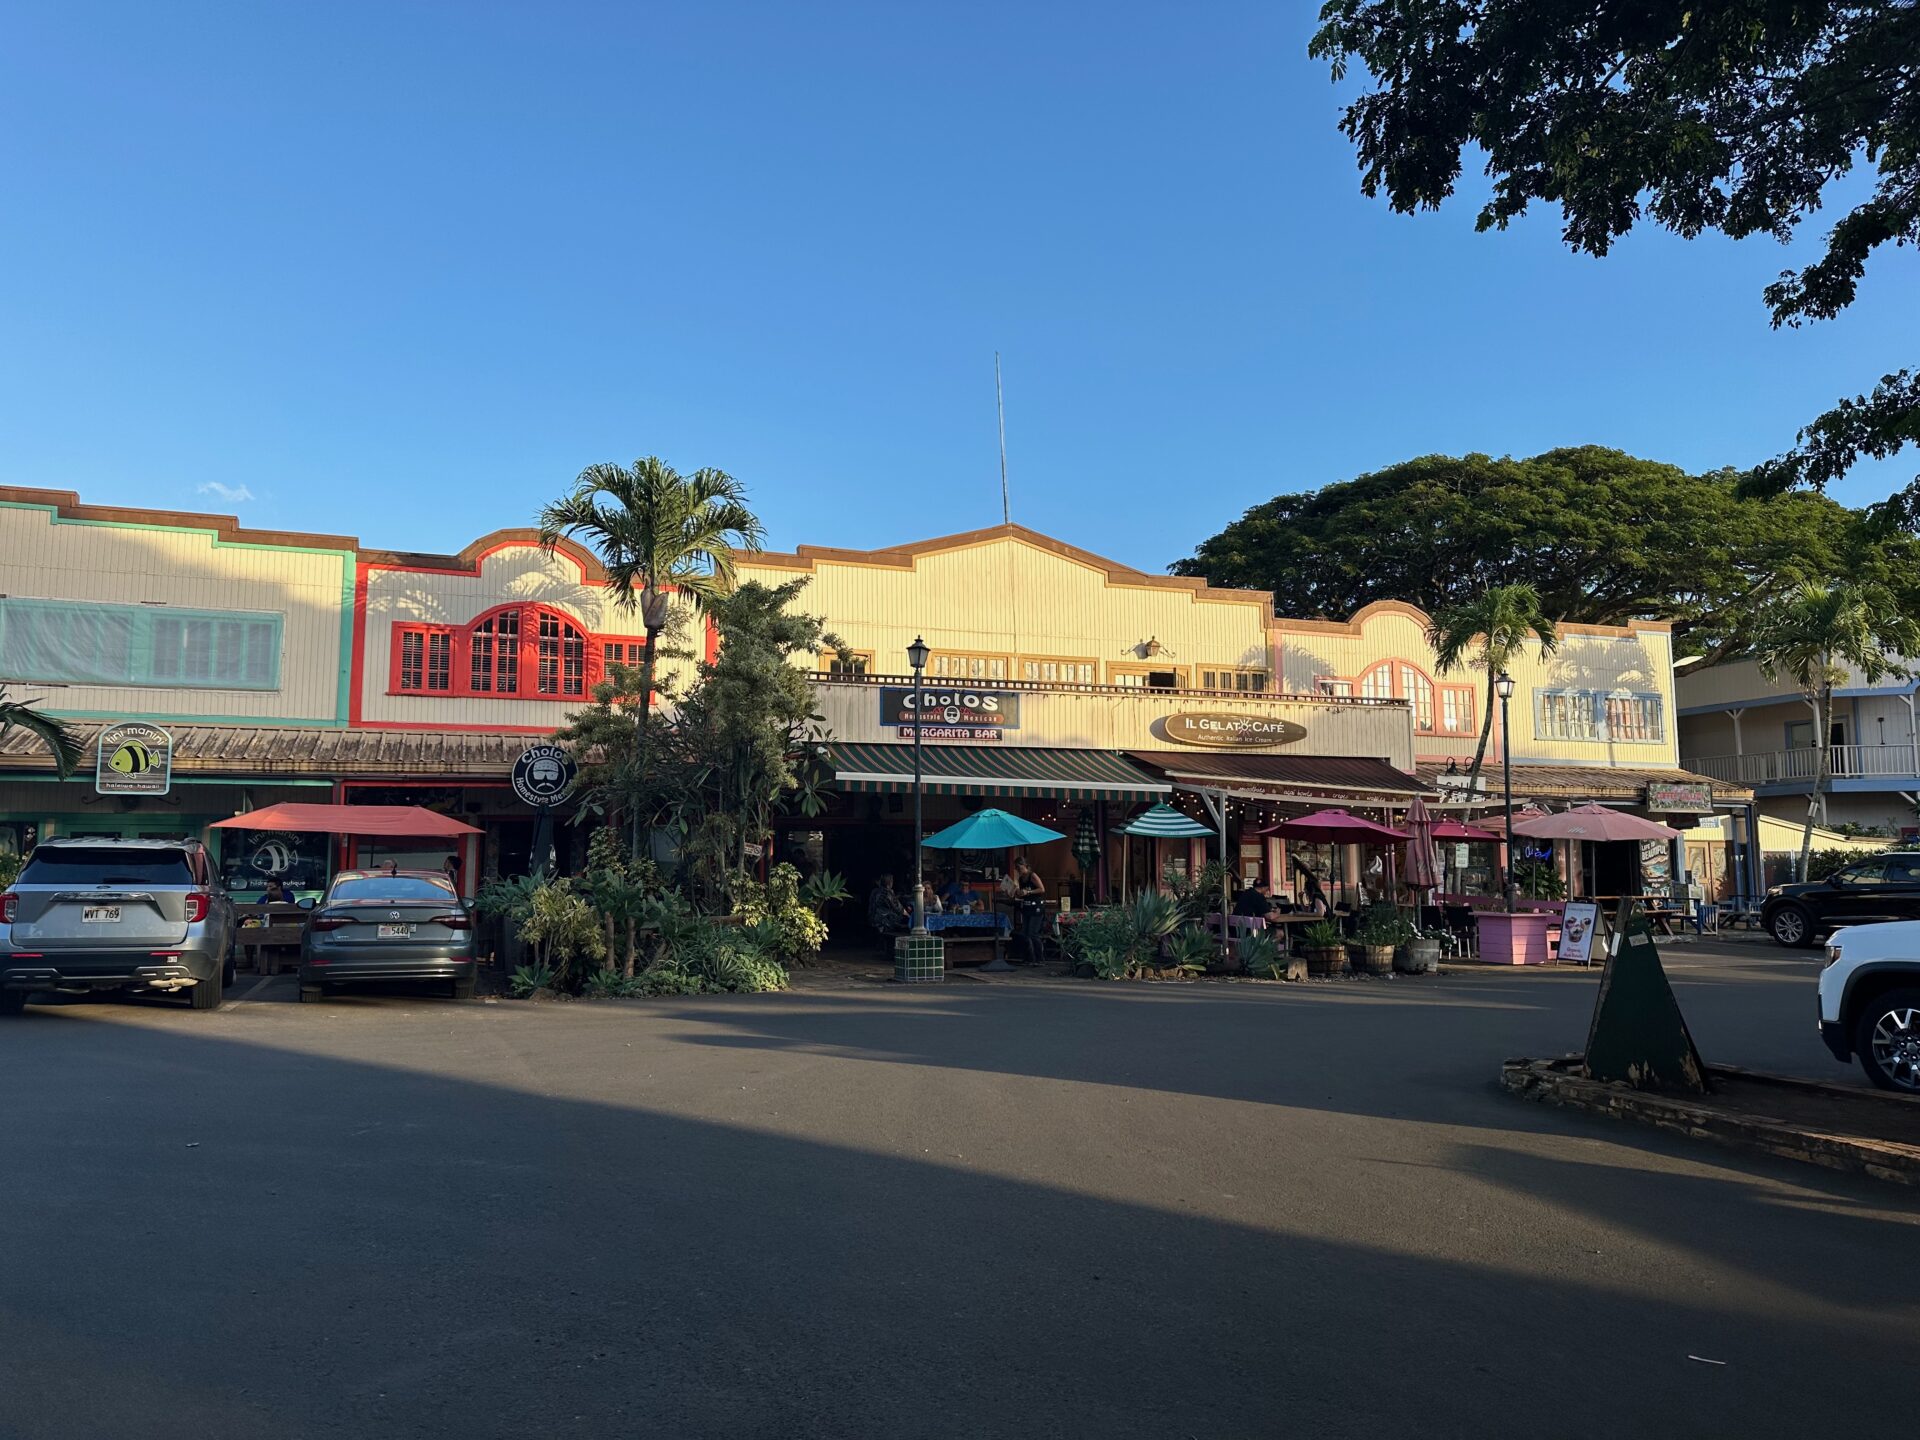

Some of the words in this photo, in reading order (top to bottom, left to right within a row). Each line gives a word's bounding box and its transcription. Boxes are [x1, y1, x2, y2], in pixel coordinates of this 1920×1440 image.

[903, 692, 999, 711] Cholos
[964, 713, 998, 722] Mexican
[1252, 720, 1285, 733] CAFÉ
[105, 730, 125, 744] tini
[127, 727, 168, 745] manini
[904, 728, 970, 738] MRGARITA
[975, 729, 998, 739] BAR
[1198, 733, 1224, 741] Authentic
[1642, 845, 1667, 860] BEAUTIFUL
[104, 909, 121, 919] 769
